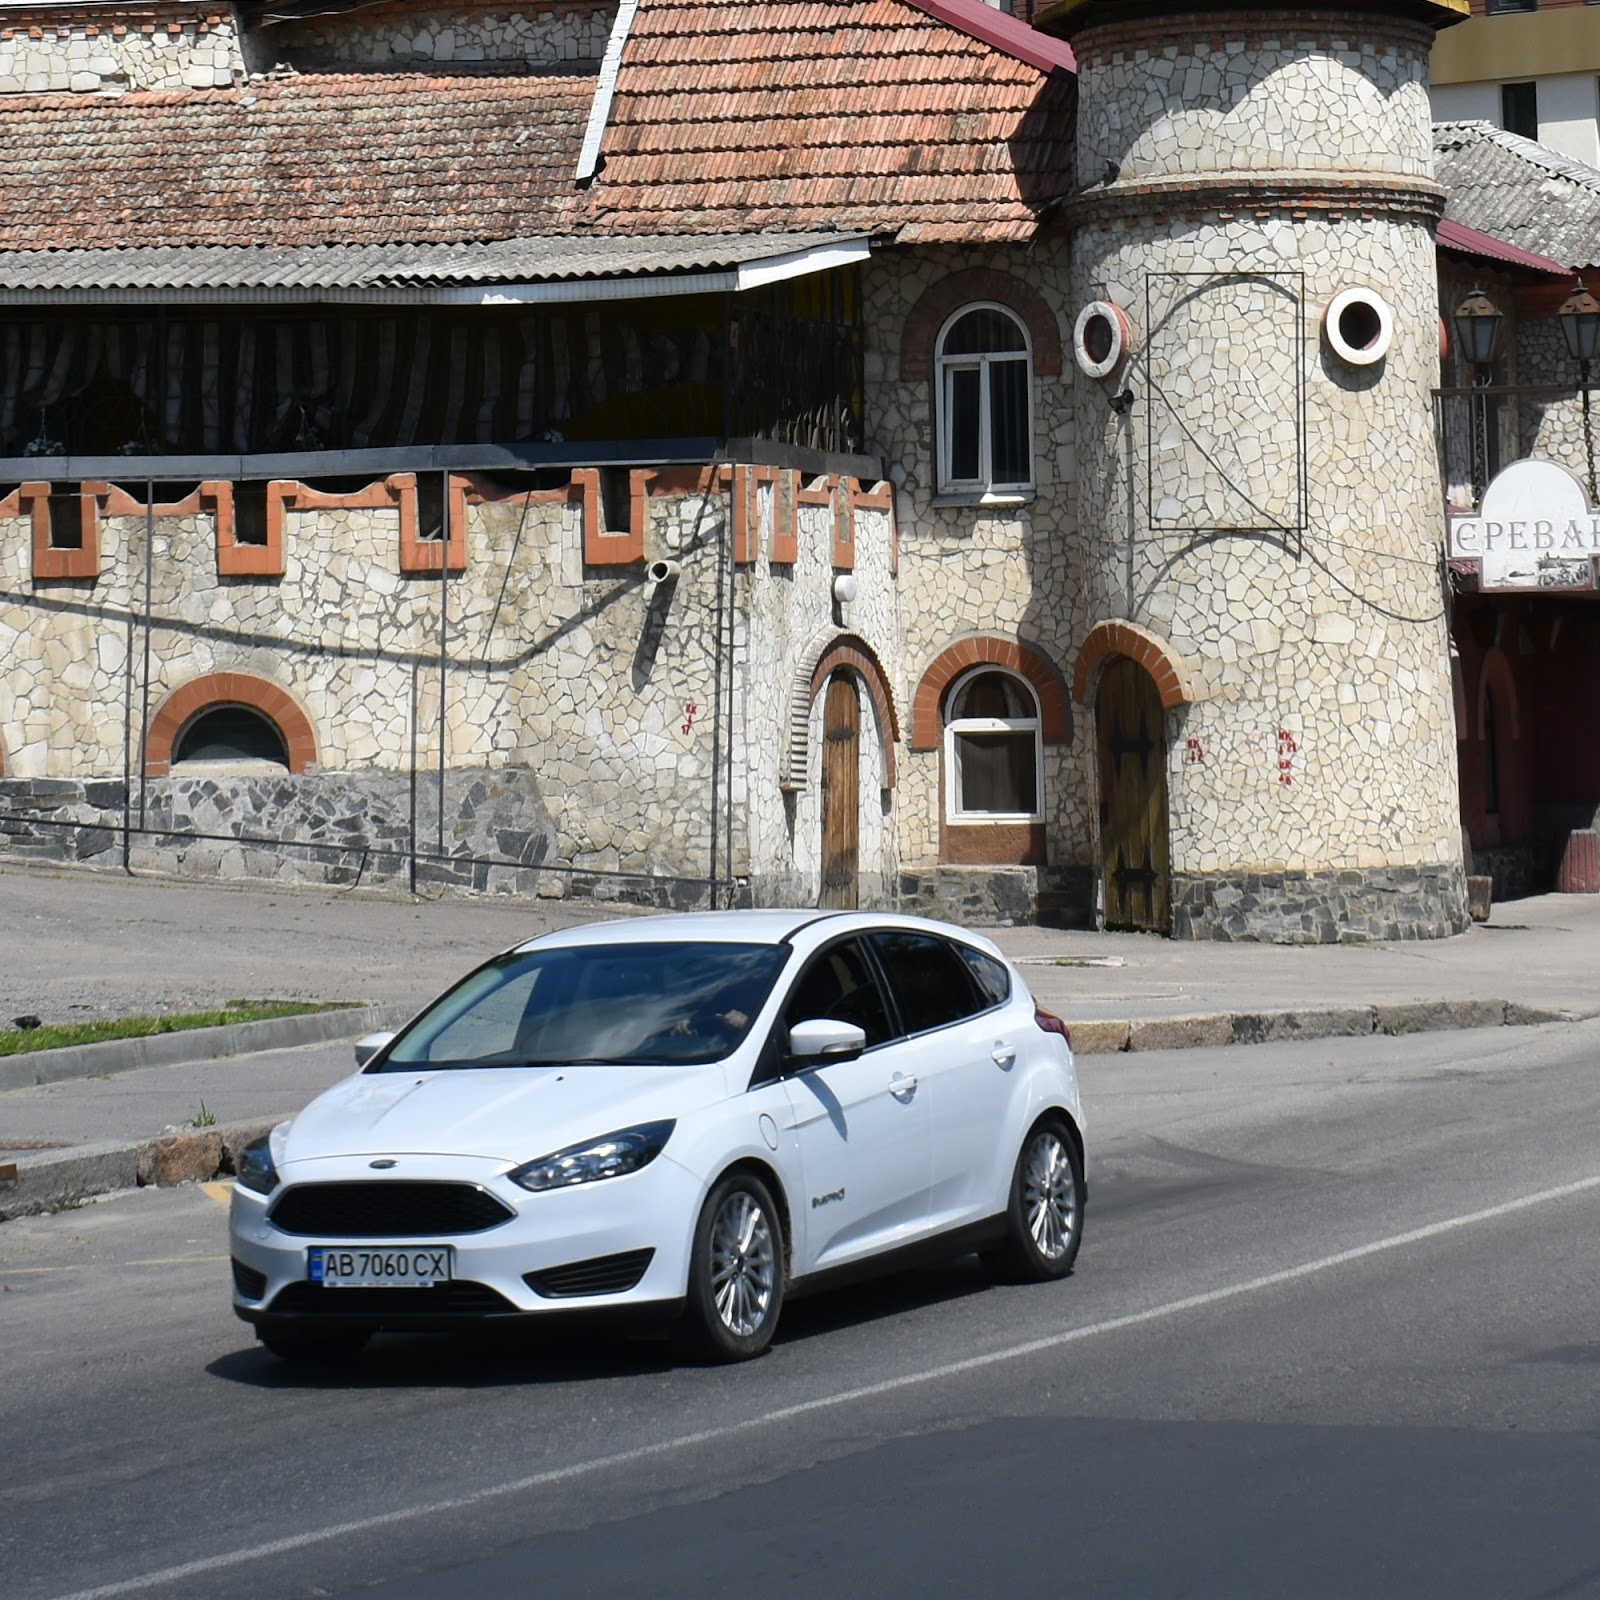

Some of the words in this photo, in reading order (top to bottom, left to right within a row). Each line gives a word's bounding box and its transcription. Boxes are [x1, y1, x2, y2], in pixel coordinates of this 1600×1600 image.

[325, 1253, 355, 1277] AB
[359, 1253, 409, 1277] 7060
[414, 1253, 445, 1277] CX
